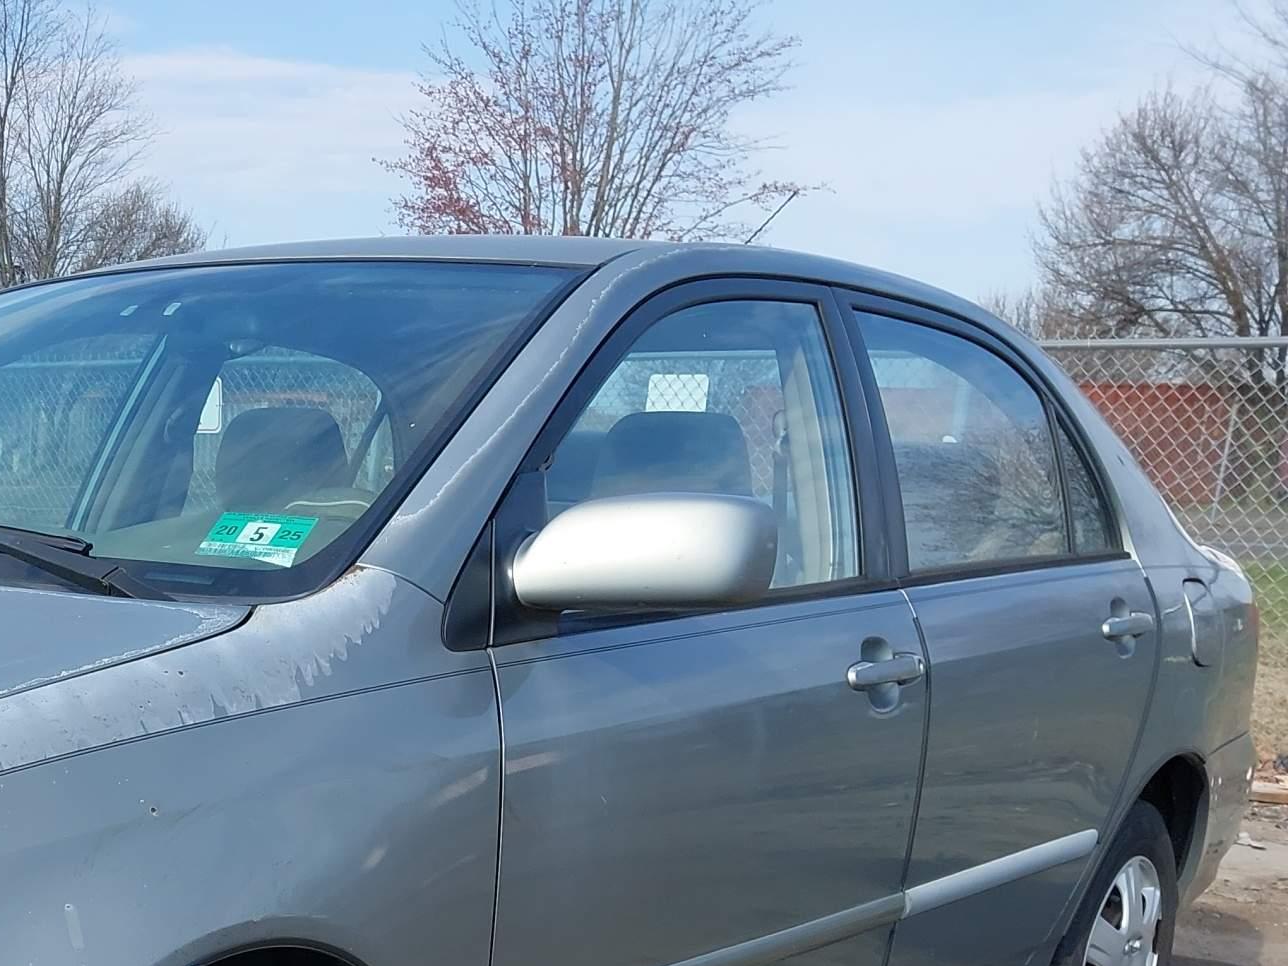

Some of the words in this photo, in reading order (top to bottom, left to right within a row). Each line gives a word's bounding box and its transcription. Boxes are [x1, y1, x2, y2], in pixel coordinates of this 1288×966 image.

[215, 525, 239, 536] 20
[249, 526, 269, 542] 5
[279, 529, 305, 541] 25
